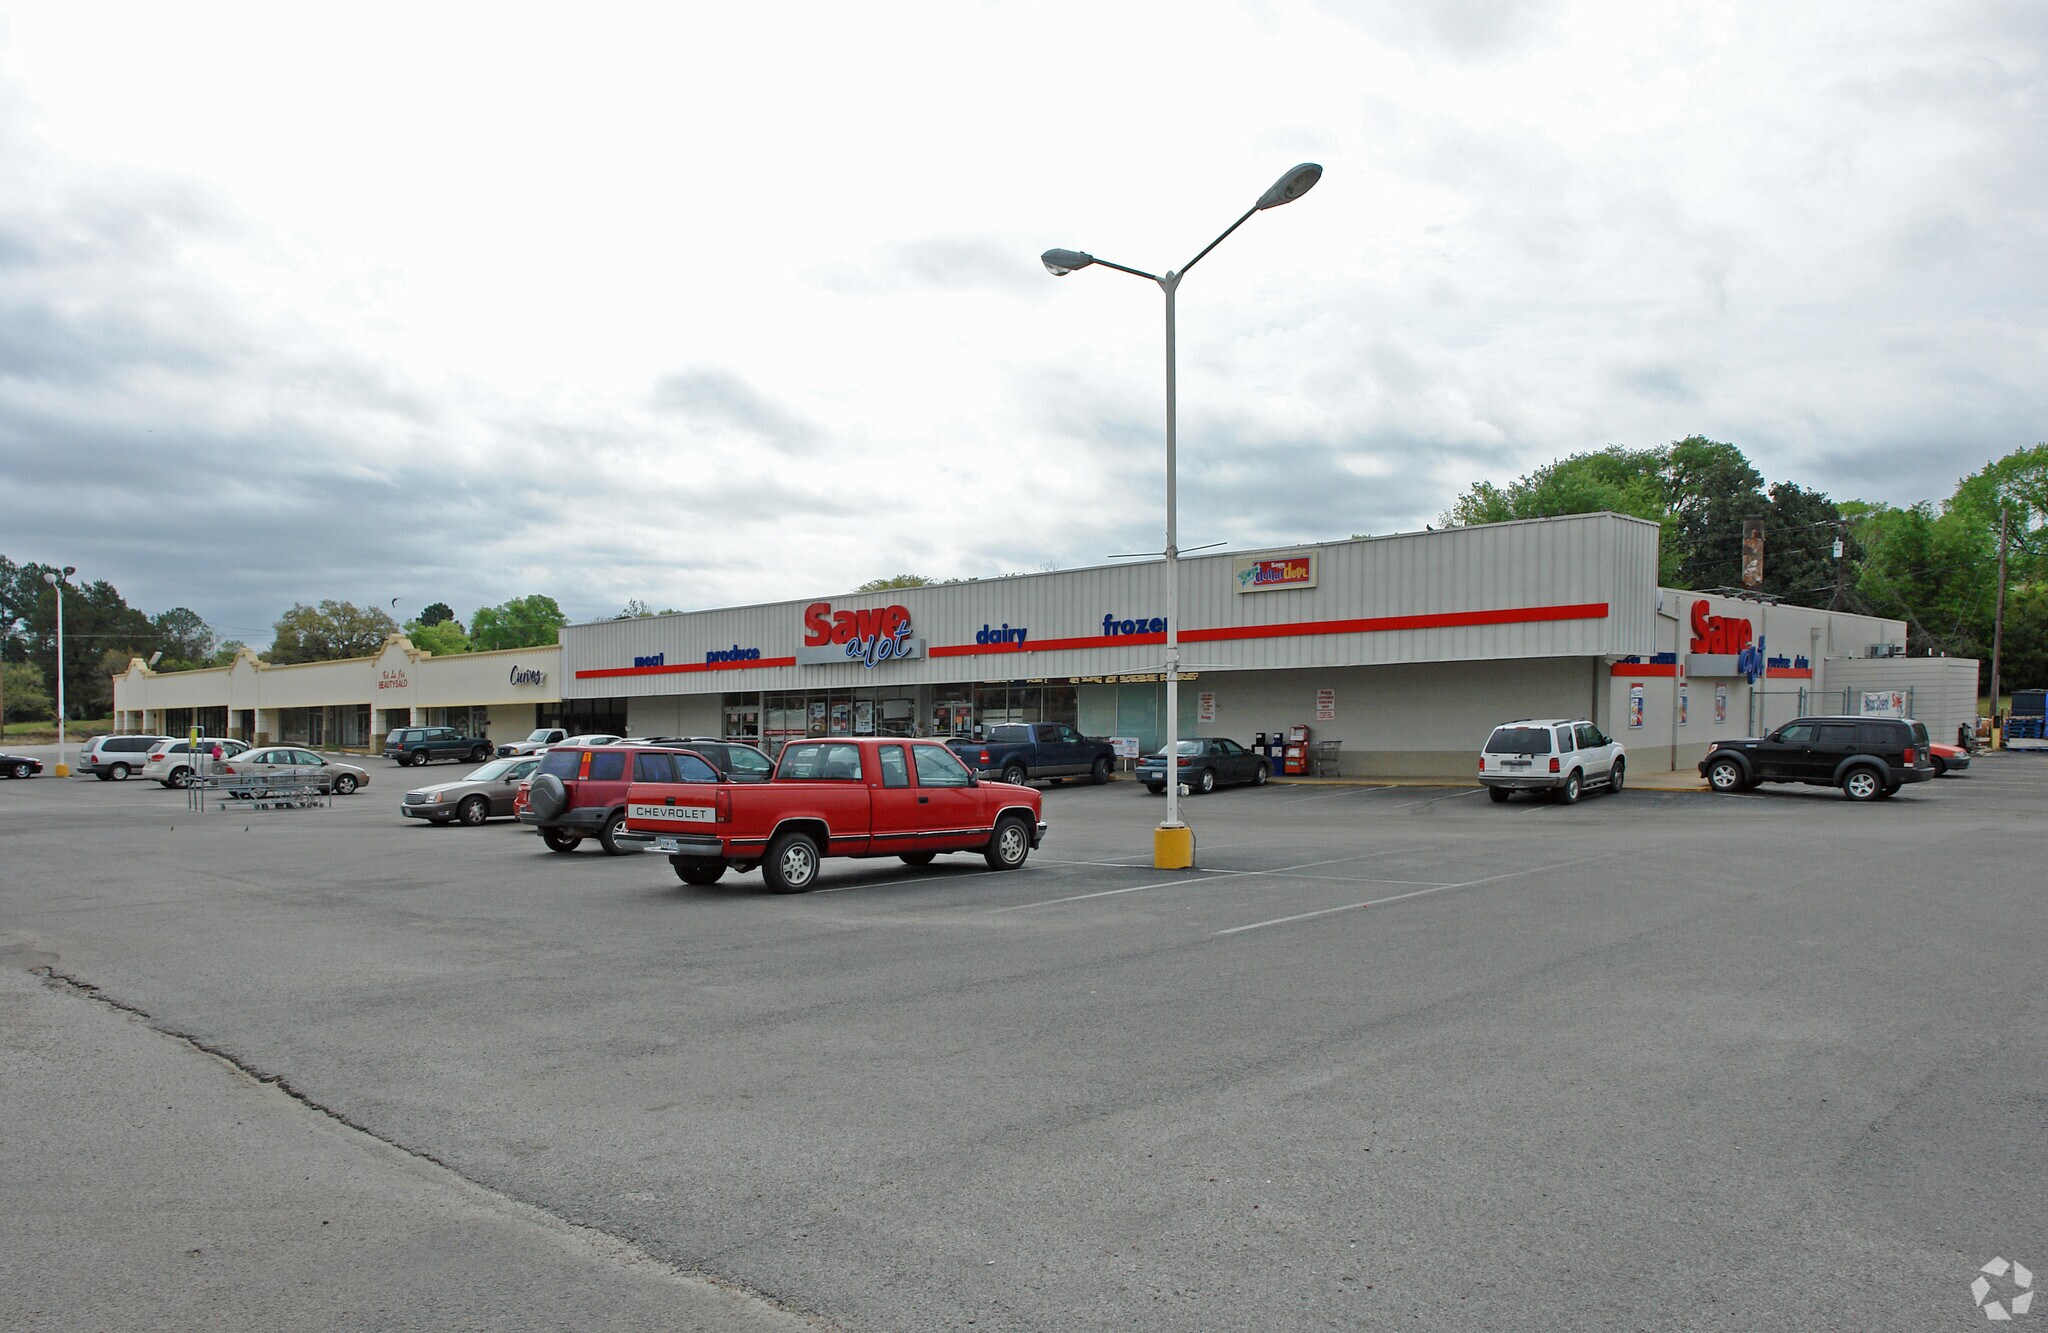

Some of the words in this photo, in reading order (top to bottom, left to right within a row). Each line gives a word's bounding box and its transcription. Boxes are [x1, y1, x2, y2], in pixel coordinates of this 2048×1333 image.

[805, 602, 911, 647] Save
[976, 624, 1027, 648] dairy
[1690, 600, 1752, 655] Save
[634, 652, 664, 667] meat
[706, 644, 760, 667] produce
[510, 665, 542, 685] Curves
[636, 807, 706, 818] CHEVROLET
